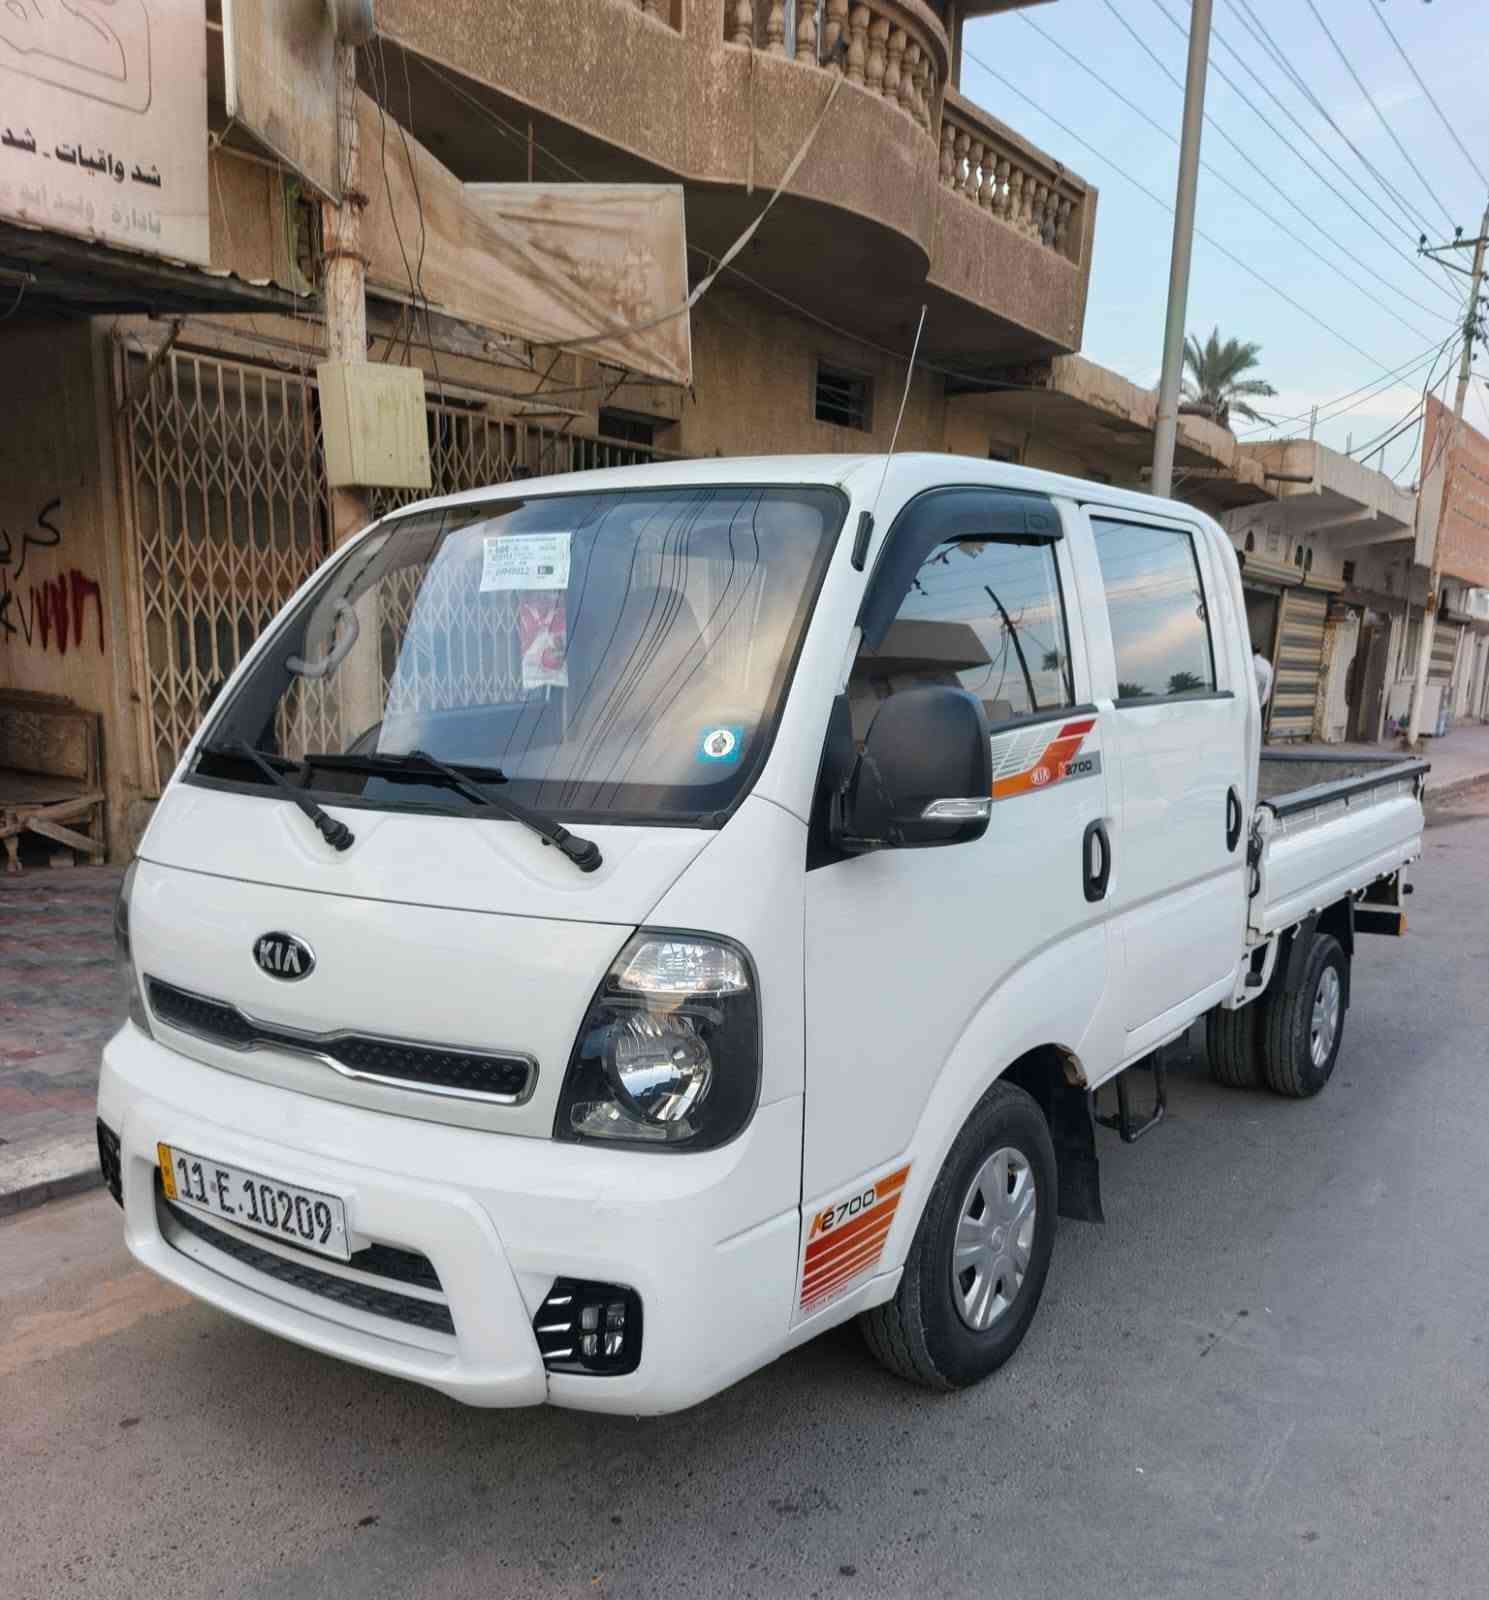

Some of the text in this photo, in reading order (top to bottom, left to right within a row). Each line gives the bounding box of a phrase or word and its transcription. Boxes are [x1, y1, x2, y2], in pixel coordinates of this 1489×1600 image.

[1, 127, 36, 153] شد
[55, 143, 125, 183] واقيات
[131, 164, 161, 187] شد
[259, 939, 302, 974] KIA
[177, 1157, 209, 1205] 11
